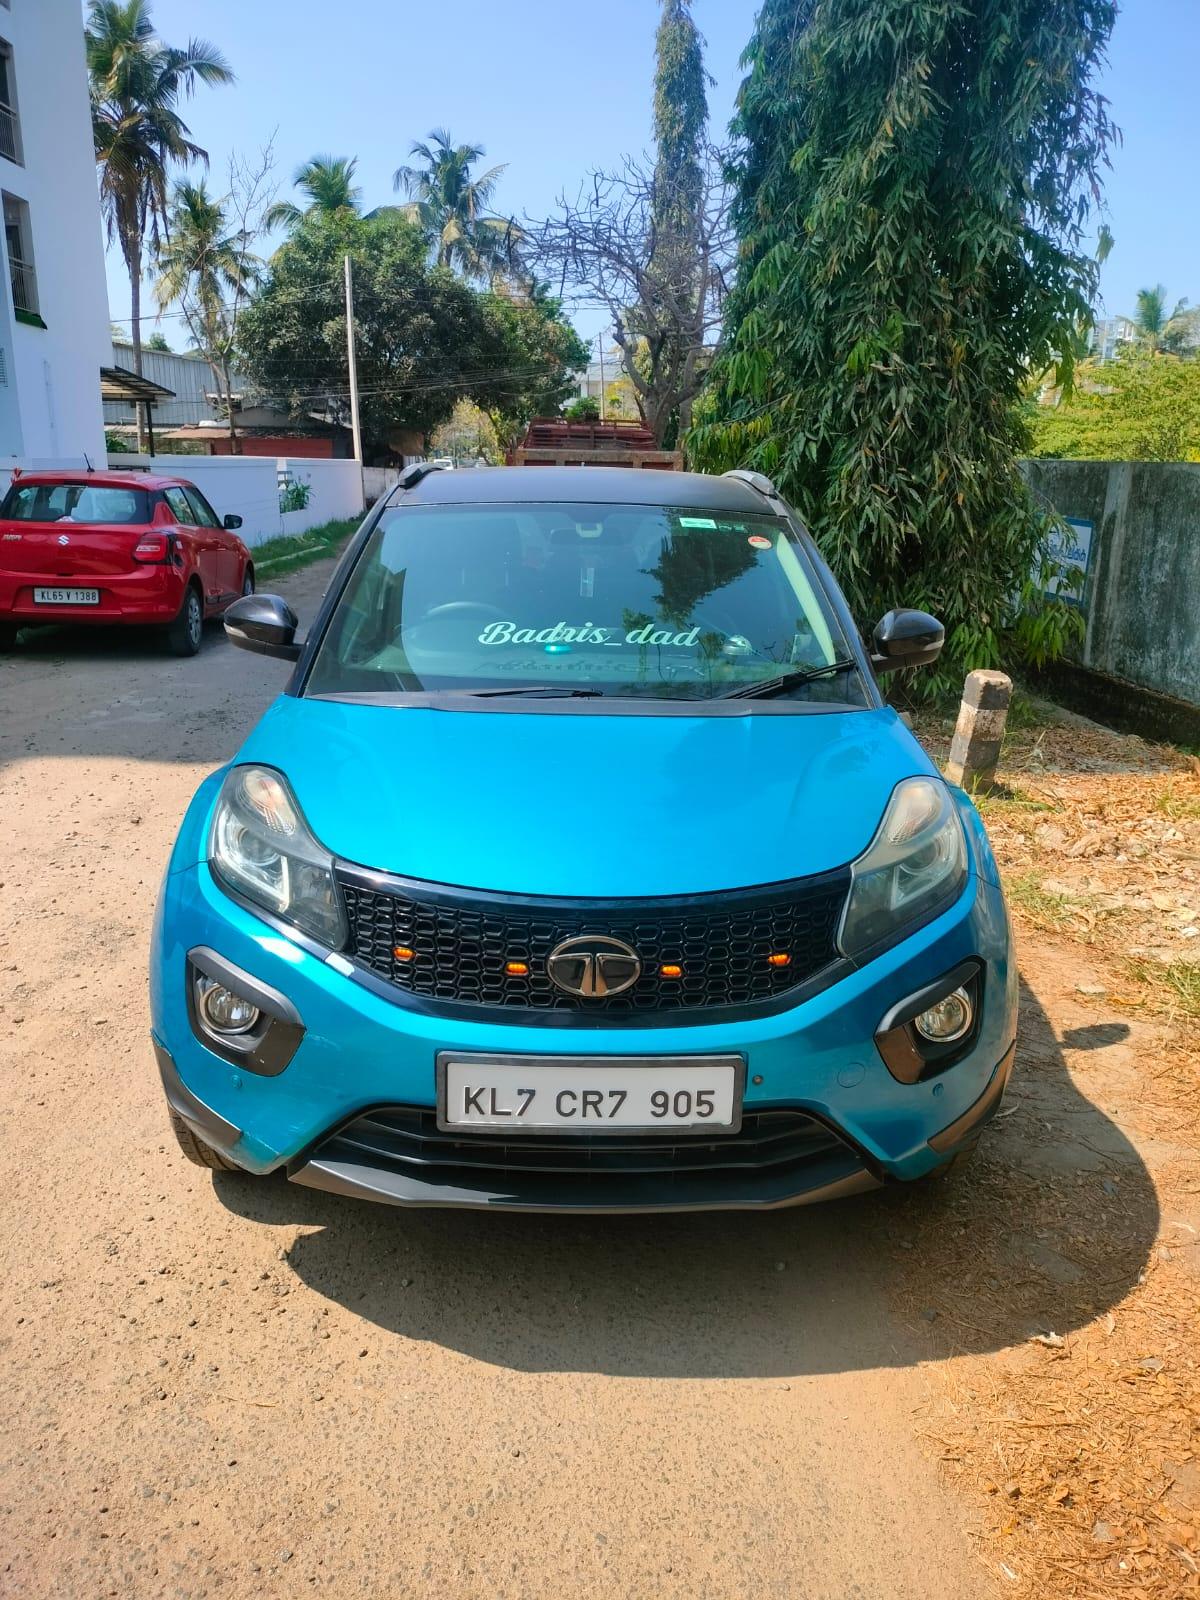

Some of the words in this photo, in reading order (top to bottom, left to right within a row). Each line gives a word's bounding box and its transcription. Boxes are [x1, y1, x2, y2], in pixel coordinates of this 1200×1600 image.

[41, 591, 64, 601] KL65
[66, 591, 71, 601] V
[75, 591, 97, 601] 1388
[463, 1085, 536, 1117] KL7
[555, 1089, 628, 1118] CR7
[650, 1089, 715, 1118] 905
